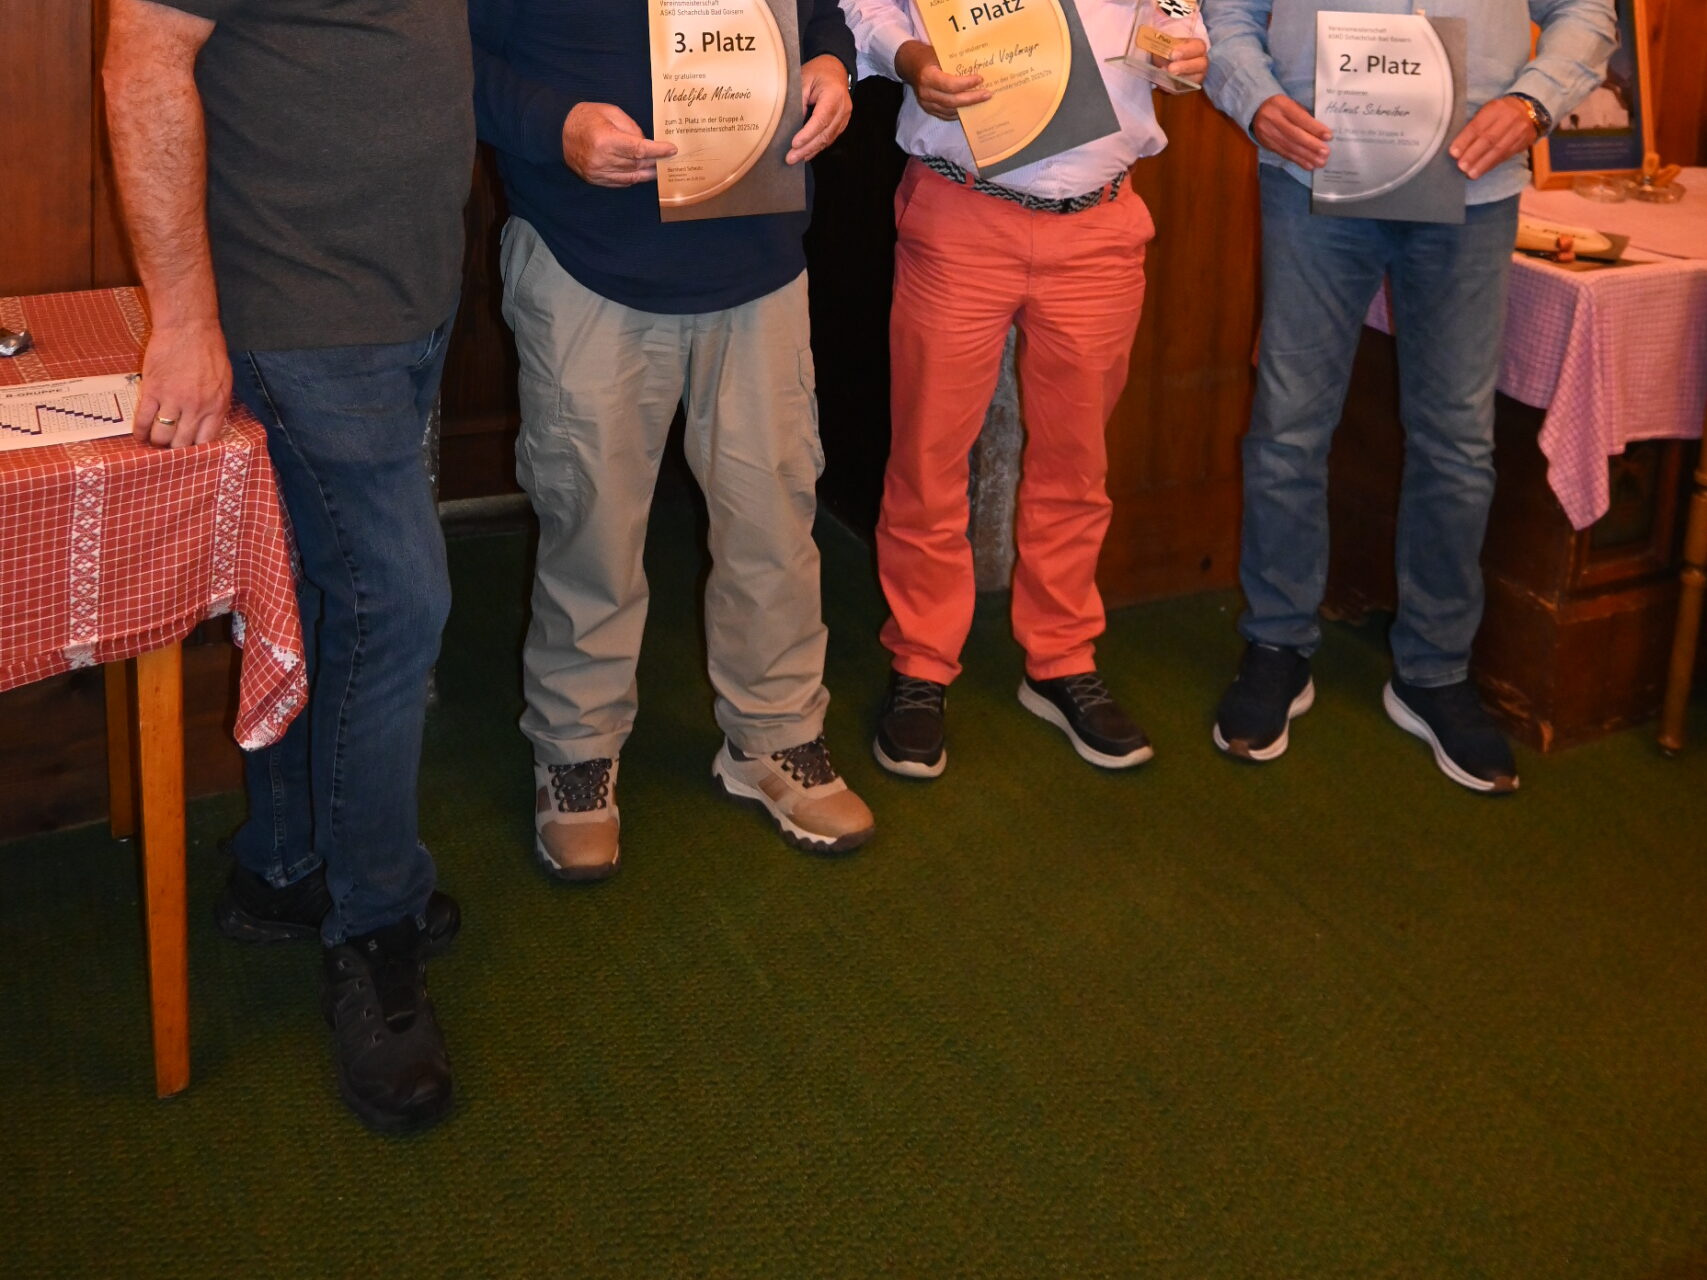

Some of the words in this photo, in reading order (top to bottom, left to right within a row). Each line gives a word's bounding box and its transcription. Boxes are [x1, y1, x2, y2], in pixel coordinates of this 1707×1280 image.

[660, 0, 720, 8] Vereinsmeisterschaft
[677, 8, 710, 17] Schachclub
[710, 8, 722, 16] Bad
[948, 14, 967, 33] 1.
[674, 32, 693, 53] 3.
[702, 30, 756, 53] Platz
[955, 53, 995, 77] Siegfried
[998, 43, 1040, 64] Voglmayr
[1339, 53, 1358, 73] 2.
[1366, 54, 1422, 76] Platz
[663, 87, 708, 107] Nedeljko
